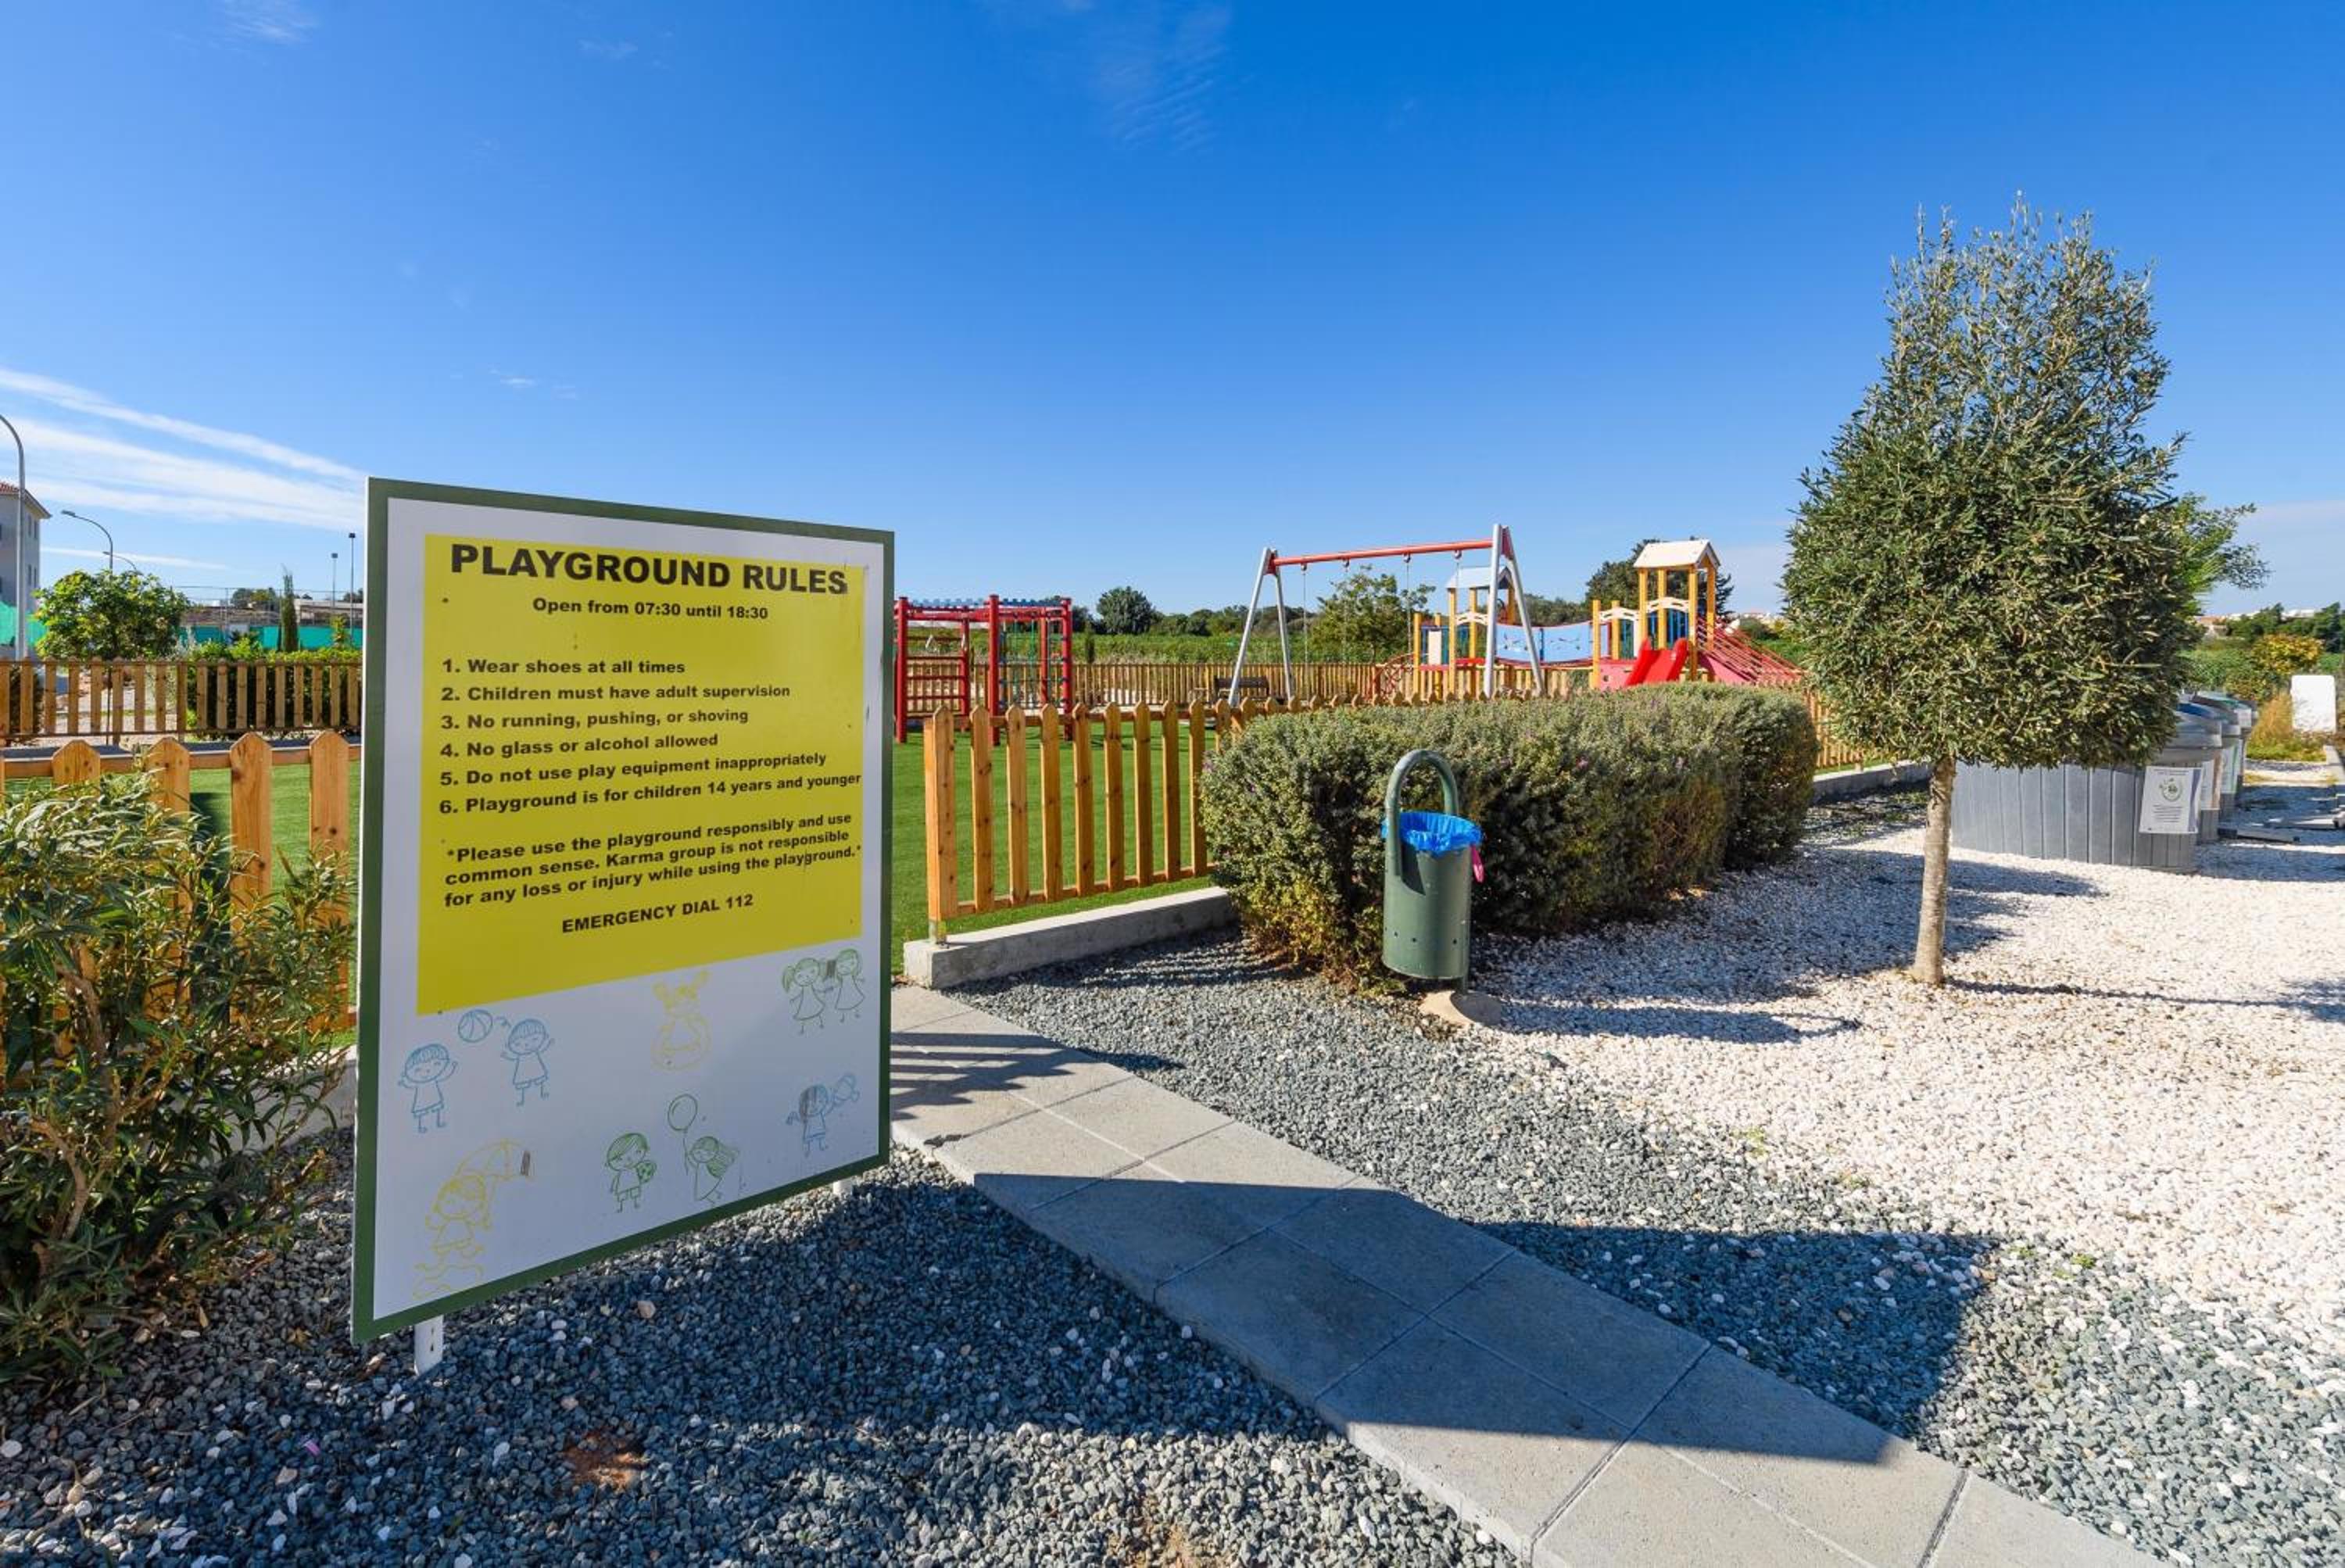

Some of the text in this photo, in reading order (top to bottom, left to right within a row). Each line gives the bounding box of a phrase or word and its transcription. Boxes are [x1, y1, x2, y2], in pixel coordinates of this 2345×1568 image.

[452, 544, 847, 594] PLAYGROUND RULES
[533, 598, 768, 619] Open from 07:30 until 18:30
[442, 659, 685, 673] 1. Wear shoes at all times
[441, 686, 789, 700] 2. Children must have adult supervision
[442, 710, 748, 729] 3. No running, pushing, or shoving
[440, 734, 718, 758] 4. No glass or alcohol allowed
[441, 753, 825, 786] 5. Do not use play equipment inappropriately
[439, 775, 861, 814] 6. Playground is for children 14 years and younger
[532, 843, 565, 854] use
[571, 838, 601, 850] the
[607, 826, 701, 850] playground
[707, 818, 794, 838] responsibly
[799, 814, 823, 828] and
[828, 814, 851, 825] use
[446, 830, 849, 885] common sense. Karma group is not responsible
[445, 893, 474, 907] for
[480, 889, 516, 903] any
[523, 883, 561, 897] loss
[567, 880, 586, 891] or
[593, 874, 643, 890] injury
[648, 866, 693, 881] while
[699, 861, 740, 875] using
[746, 857, 769, 869] the
[563, 894, 753, 933] EMERGENCY DIAL 112
